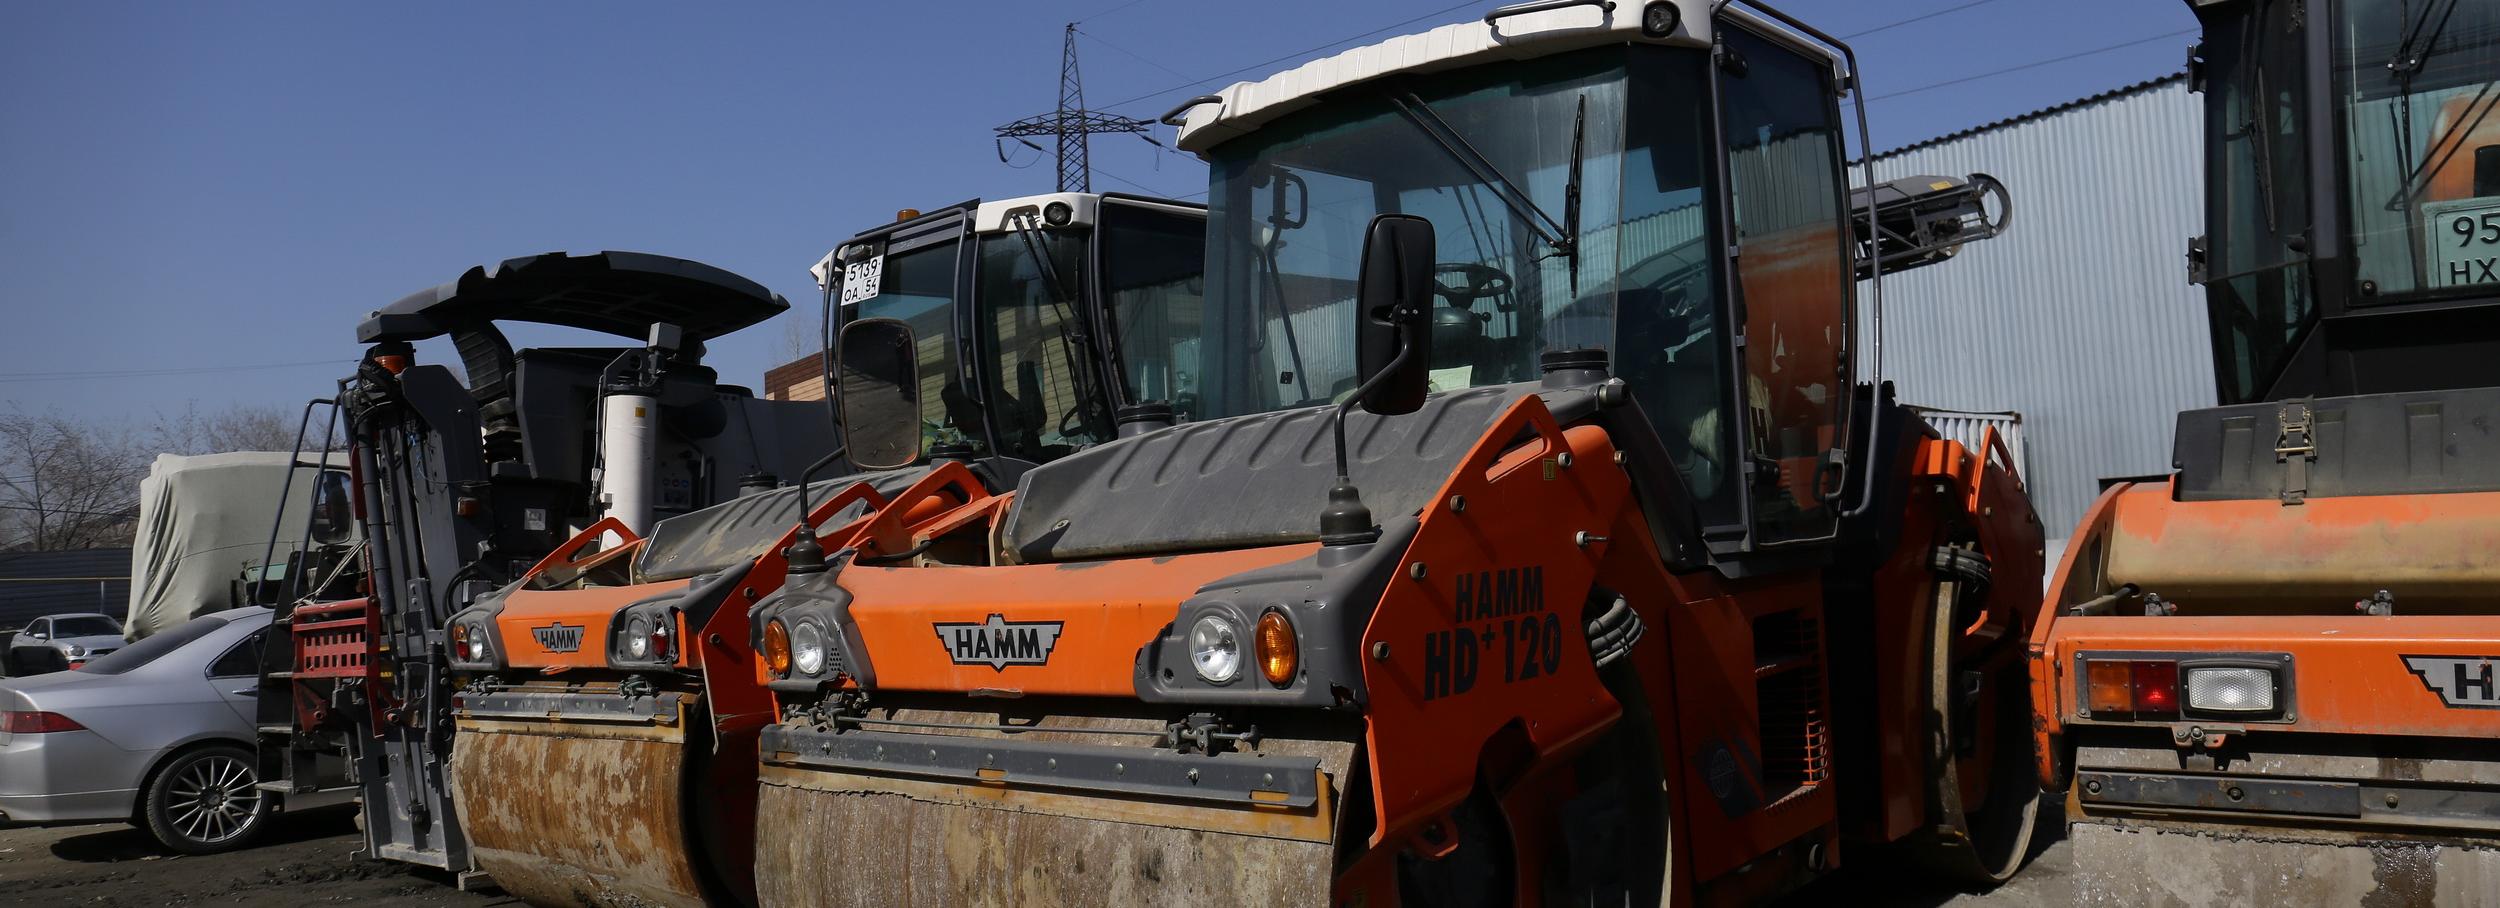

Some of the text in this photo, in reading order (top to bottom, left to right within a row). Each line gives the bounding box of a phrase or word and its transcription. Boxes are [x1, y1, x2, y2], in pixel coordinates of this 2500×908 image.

[2453, 212, 2500, 248] 95
[849, 259, 878, 281] 5139
[865, 278, 877, 293] 54
[1456, 565, 1544, 624] HAMM
[541, 630, 577, 649] HAMM
[955, 628, 1042, 659] HAMM
